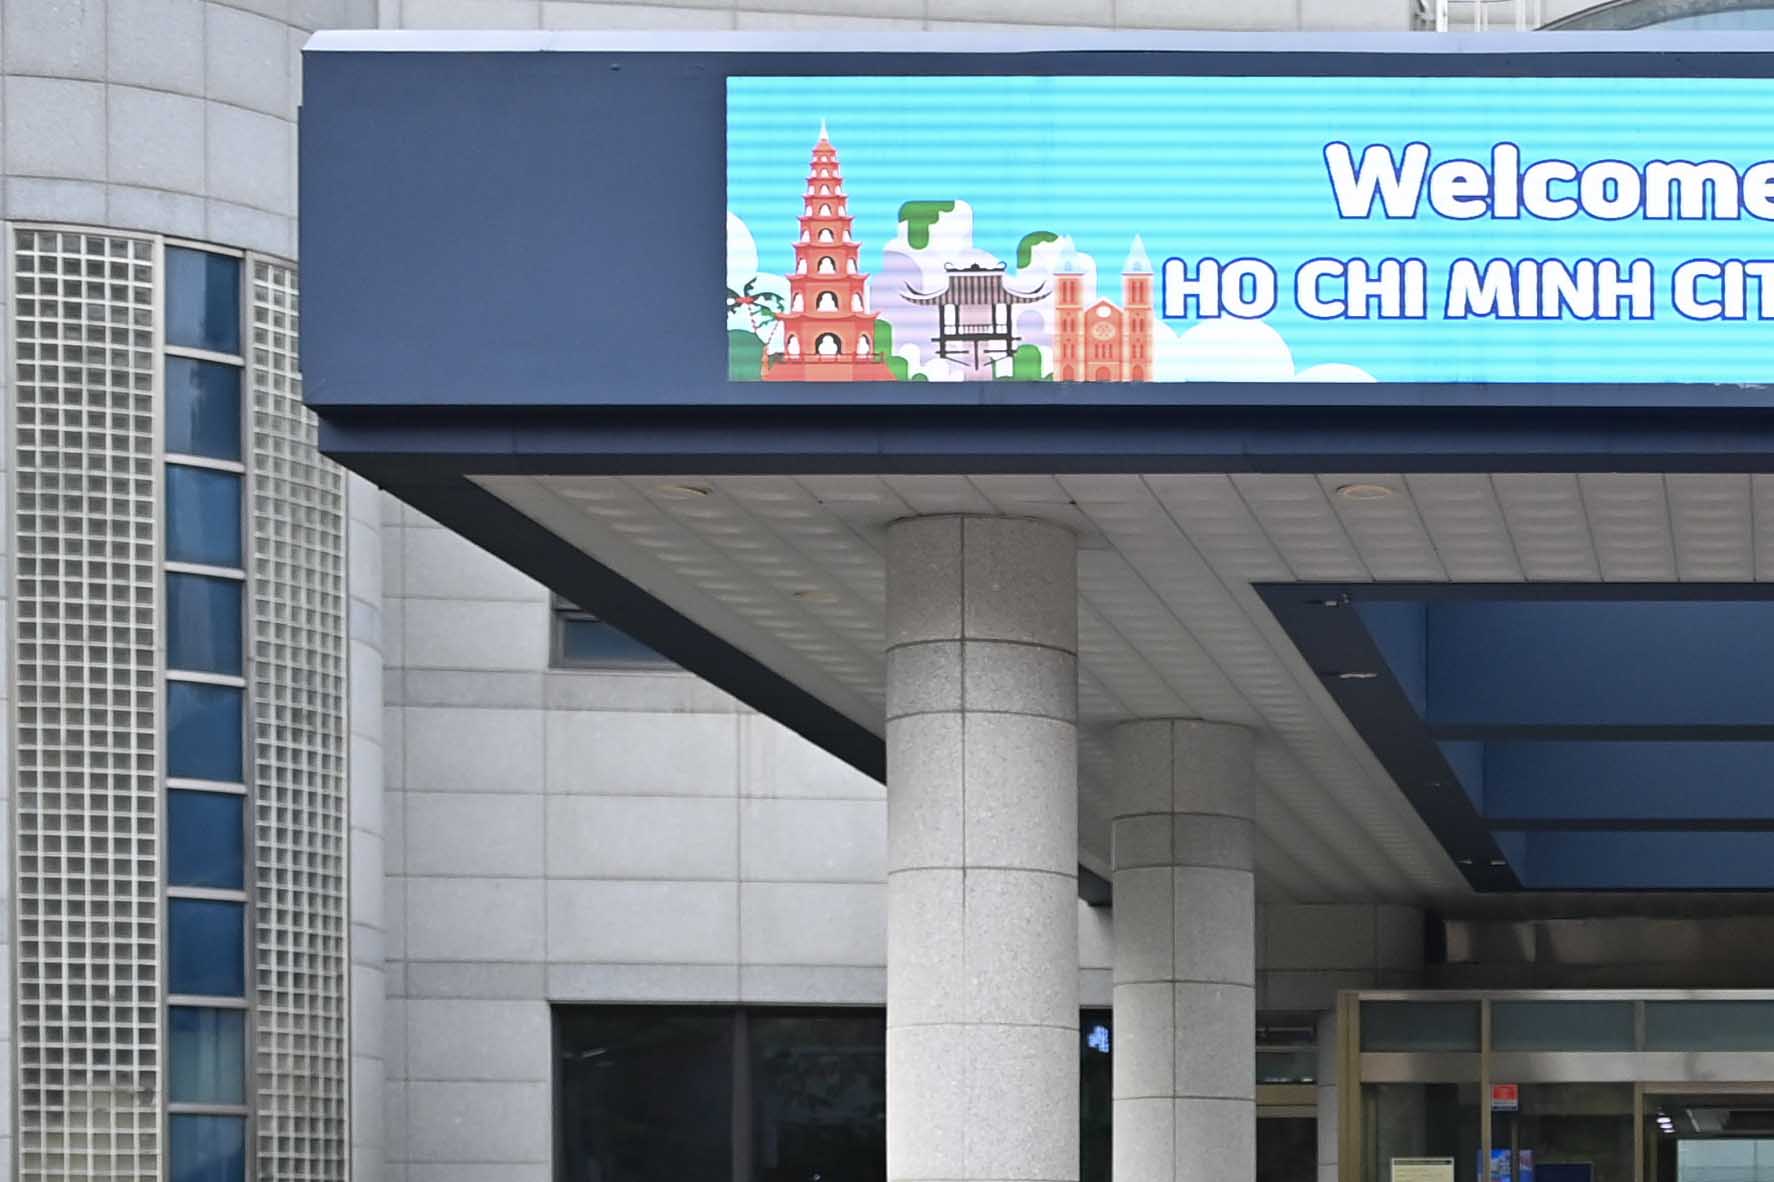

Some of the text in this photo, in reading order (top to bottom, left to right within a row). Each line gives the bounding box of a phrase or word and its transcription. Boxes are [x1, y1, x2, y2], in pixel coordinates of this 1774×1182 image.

[1162, 257, 1278, 321] HO
[1294, 257, 1427, 321] CHI
[1443, 258, 1655, 321] MINH
